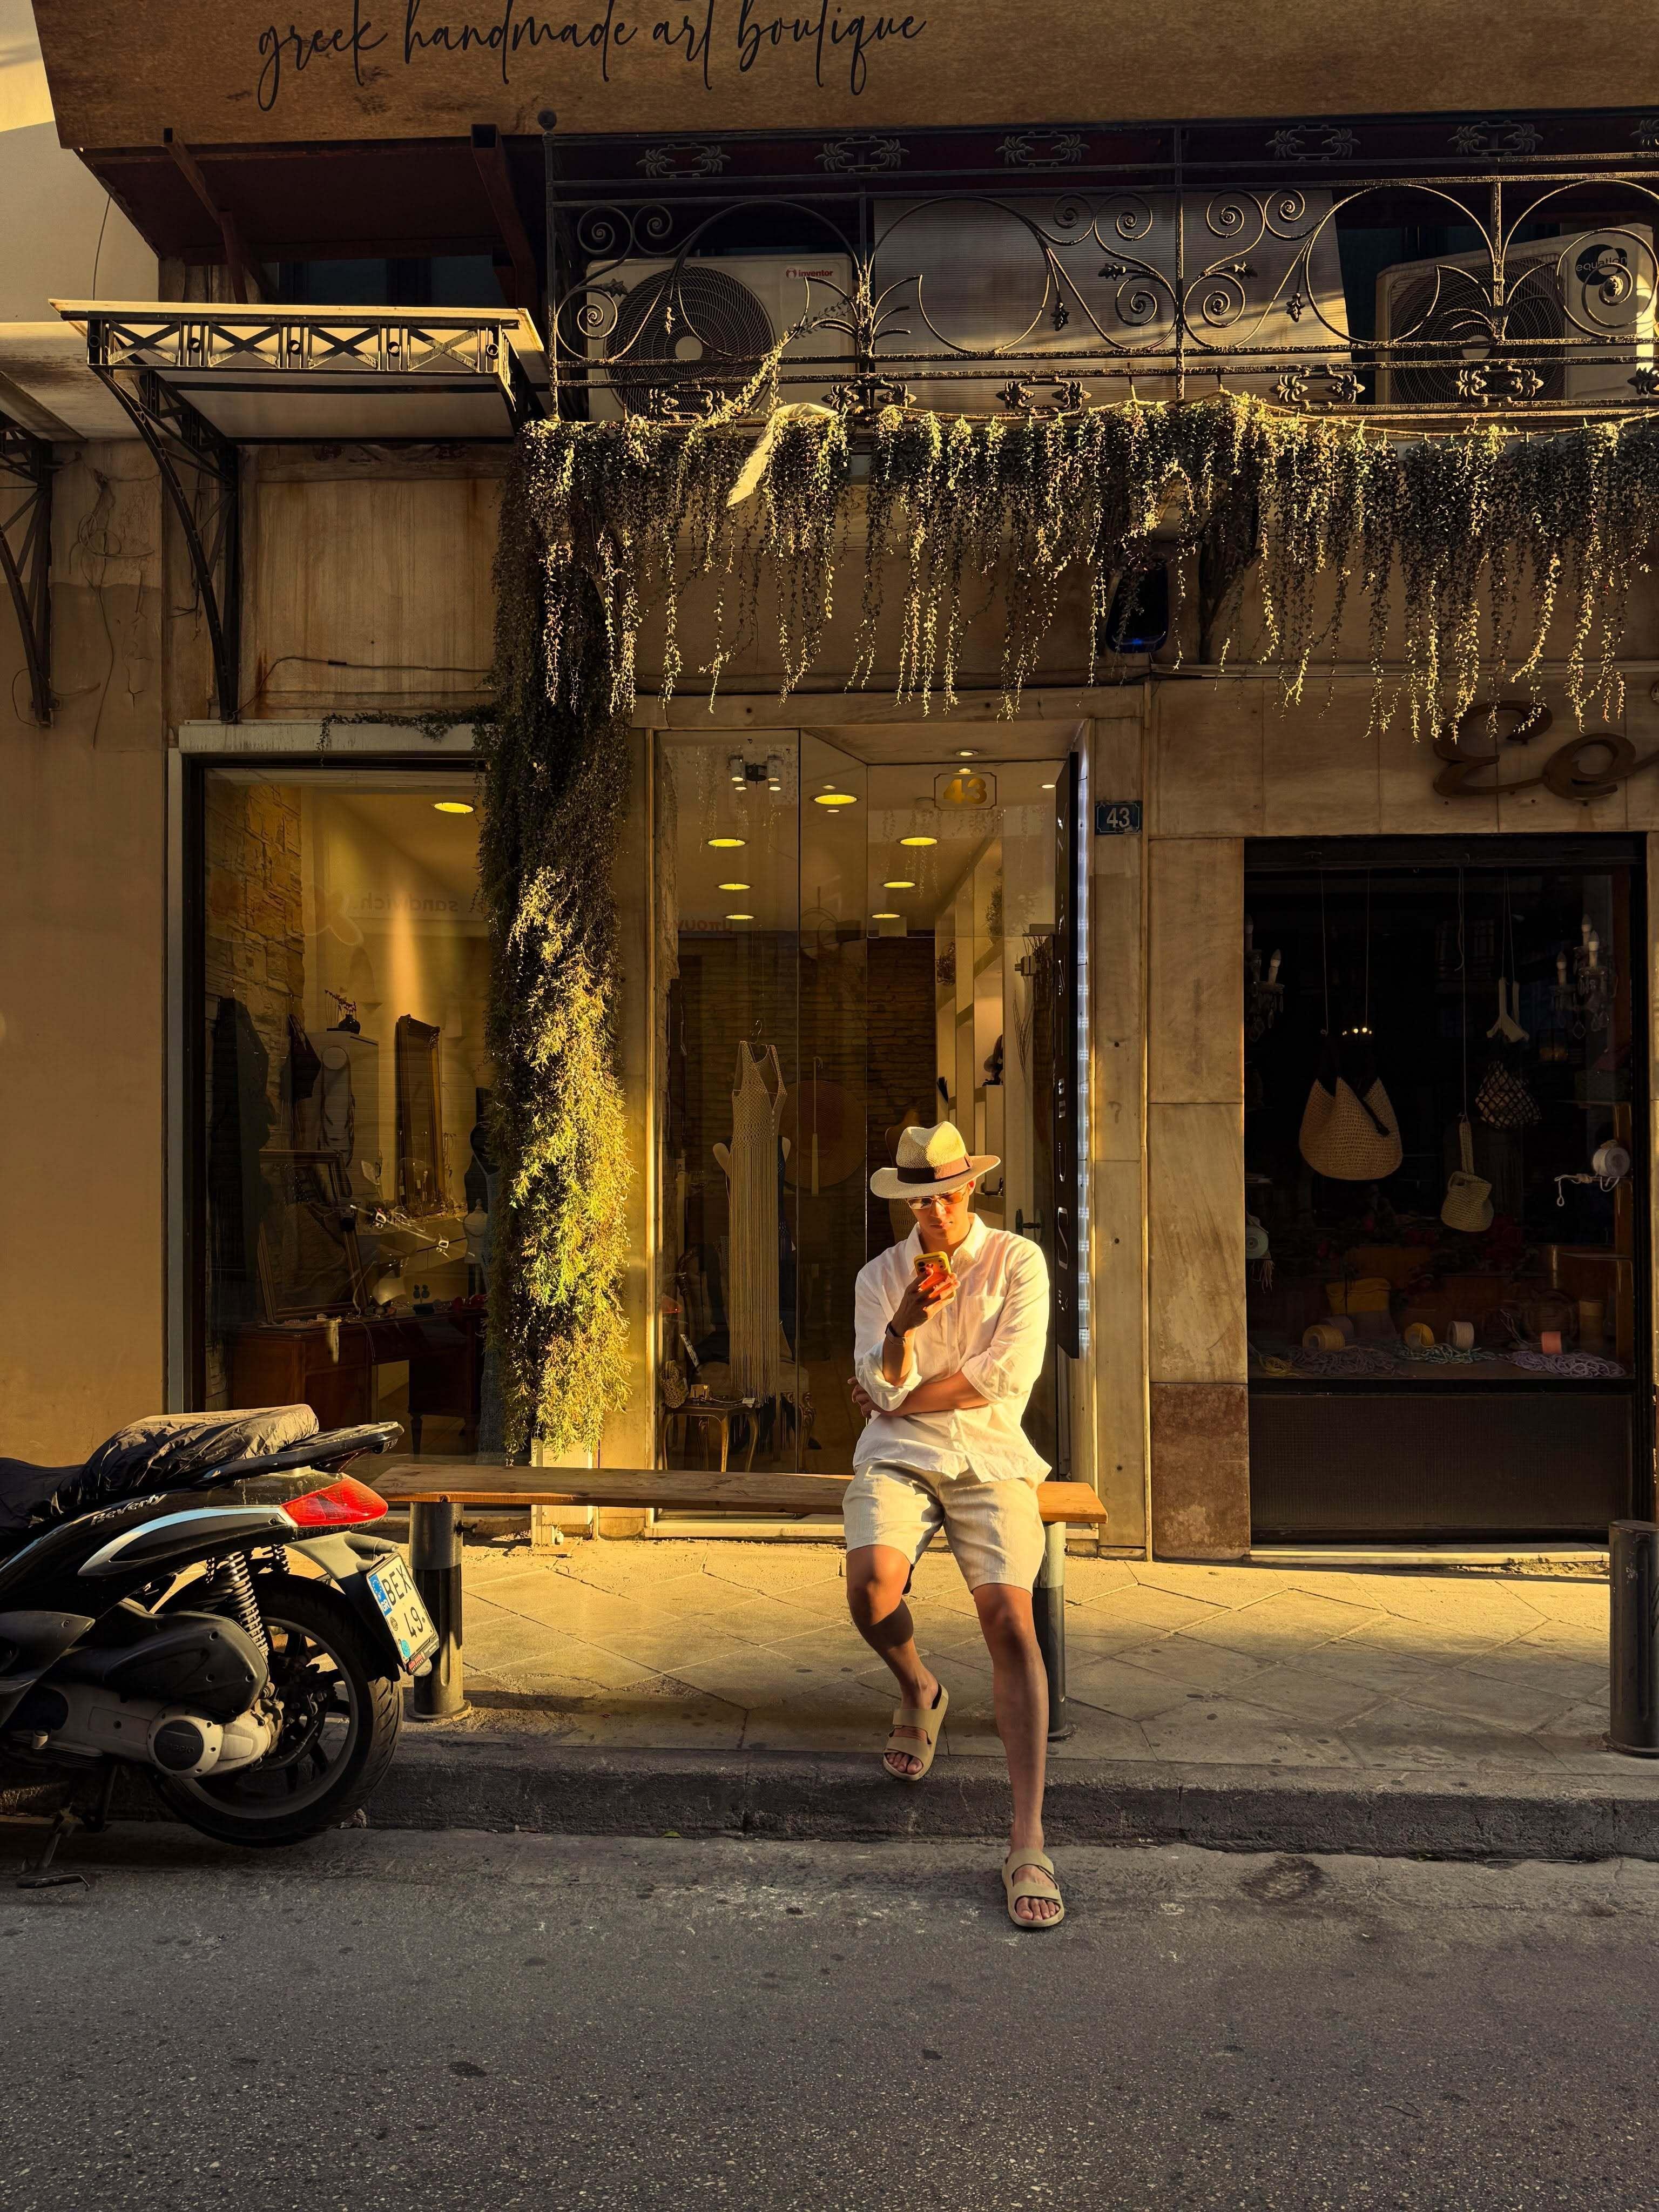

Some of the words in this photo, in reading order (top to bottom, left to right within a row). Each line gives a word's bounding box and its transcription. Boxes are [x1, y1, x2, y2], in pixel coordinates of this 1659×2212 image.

[257, 0, 388, 111] greek
[405, 0, 638, 84] handmade
[652, 0, 713, 91] art
[738, 0, 927, 96] boutique
[1576, 256, 1628, 272] equation
[943, 778, 988, 805] 43
[1106, 807, 1130, 828] 43
[381, 1564, 412, 1606] BEX
[381, 1599, 391, 1613] GR
